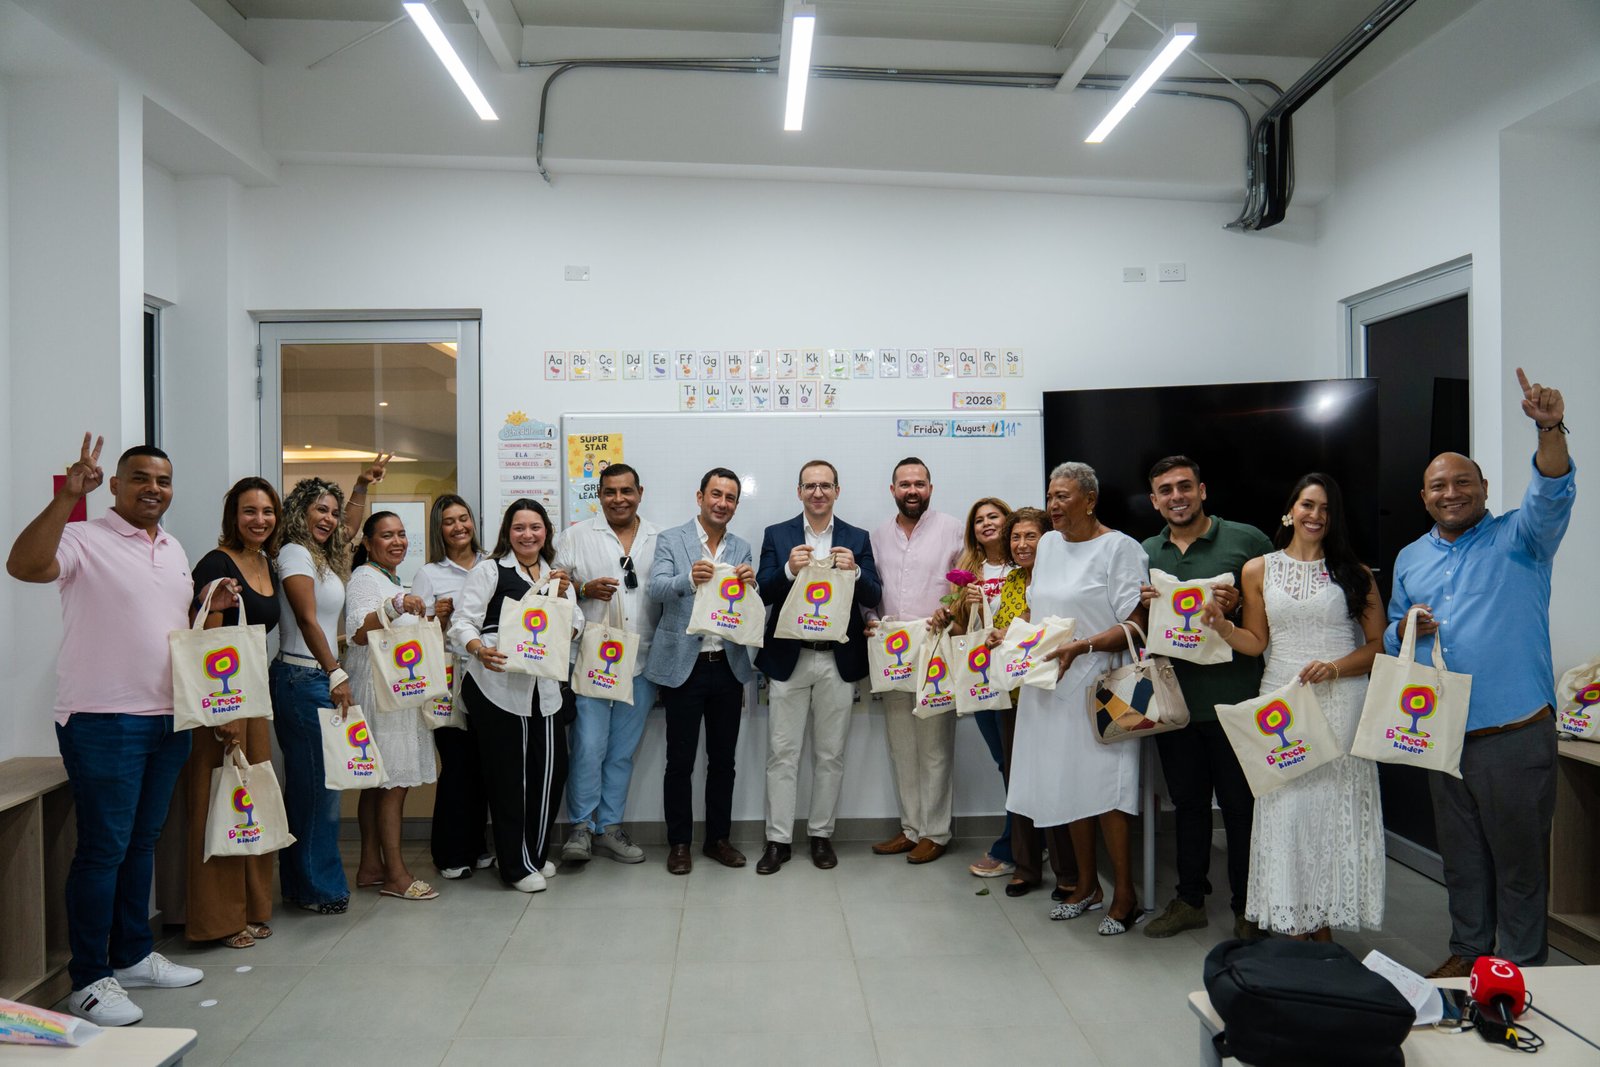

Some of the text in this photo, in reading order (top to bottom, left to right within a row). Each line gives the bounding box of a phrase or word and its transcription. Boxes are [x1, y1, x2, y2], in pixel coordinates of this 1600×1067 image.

[549, 355, 562, 364] Aa
[599, 355, 612, 364] Cc
[627, 354, 640, 364] Dd
[653, 354, 666, 364] Ee
[680, 354, 692, 364] Ff
[703, 355, 716, 367] Gg
[728, 354, 741, 365] Hh
[782, 354, 792, 366] Jj
[806, 353, 819, 363] Kk
[835, 354, 844, 363] Ll
[883, 353, 896, 362] Nn
[910, 353, 924, 363] Oo
[938, 352, 950, 364] Pp
[960, 352, 975, 364] Qq
[984, 352, 996, 362] Rr
[1006, 352, 1018, 362] Ss
[684, 385, 696, 395] Tt
[707, 386, 719, 395] Uu
[730, 385, 743, 395] Vv
[751, 385, 768, 394] Ww
[778, 385, 790, 394] Xx
[800, 384, 812, 396] Yy
[824, 384, 836, 394] Zz
[966, 396, 992, 405] 2026
[914, 425, 944, 436] Friday
[956, 424, 986, 434] August
[711, 612, 743, 625] Bureche
[798, 616, 832, 627] Bureche
[1165, 630, 1206, 642] Bureche
[517, 644, 548, 656] Bureche
[884, 667, 916, 676] Bureche
[588, 670, 619, 686] Bureche
[393, 680, 430, 693] Bureche
[202, 695, 246, 708] Bureche
[1386, 729, 1434, 749] Bureche
[1266, 744, 1311, 765] Bureche
